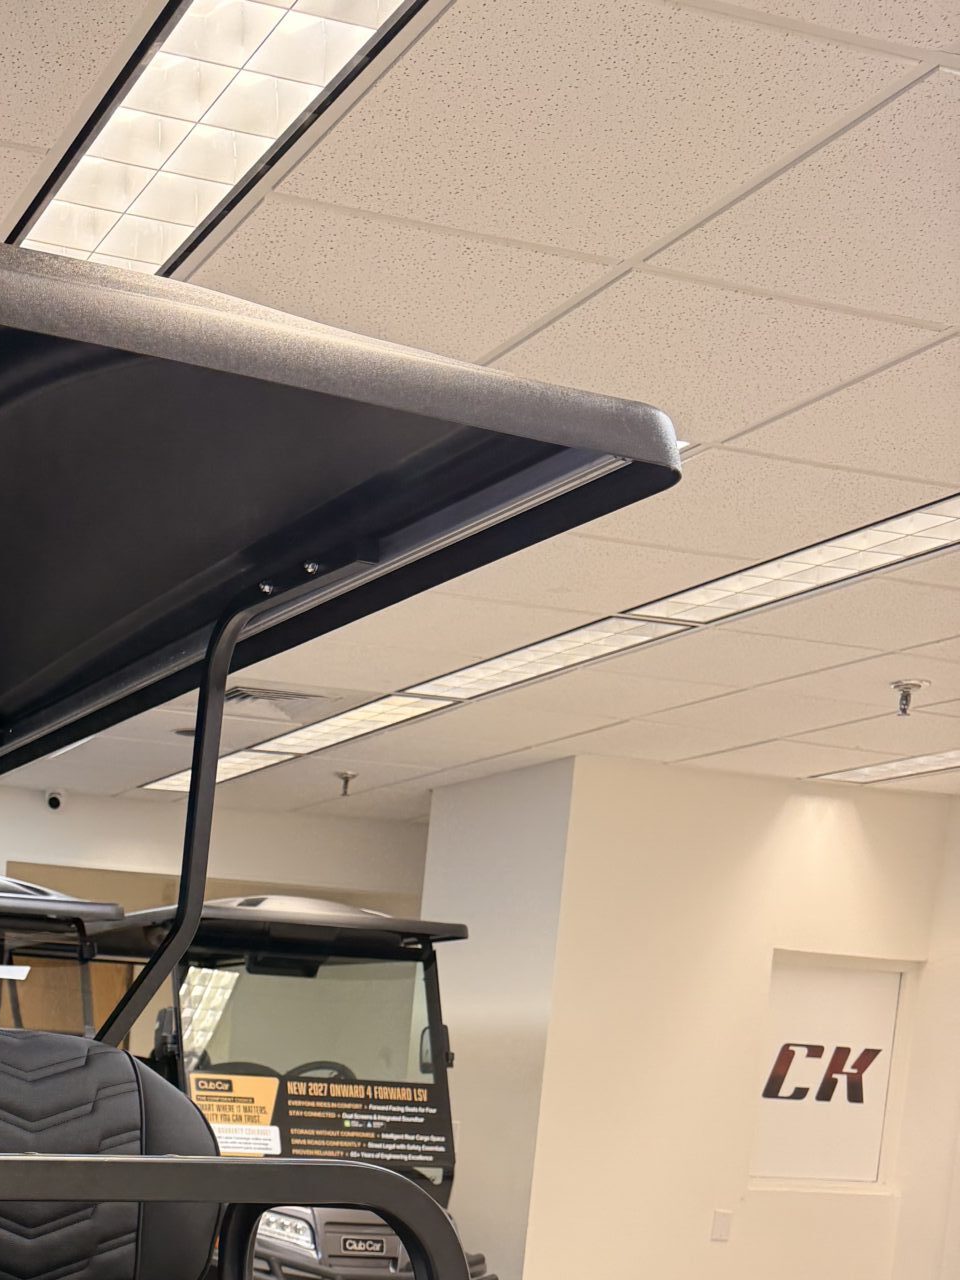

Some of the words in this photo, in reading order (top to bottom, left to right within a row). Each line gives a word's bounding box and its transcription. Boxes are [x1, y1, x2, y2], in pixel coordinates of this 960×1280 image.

[762, 1043, 882, 1103] CK
[287, 1081, 307, 1096] NEW
[308, 1083, 327, 1096] 2027
[330, 1083, 364, 1099] ONWARD
[366, 1085, 372, 1099] 4
[374, 1086, 411, 1101] FORWARD
[414, 1088, 428, 1102] LSV
[346, 1240, 366, 1251] Club
[366, 1241, 382, 1252] Car
